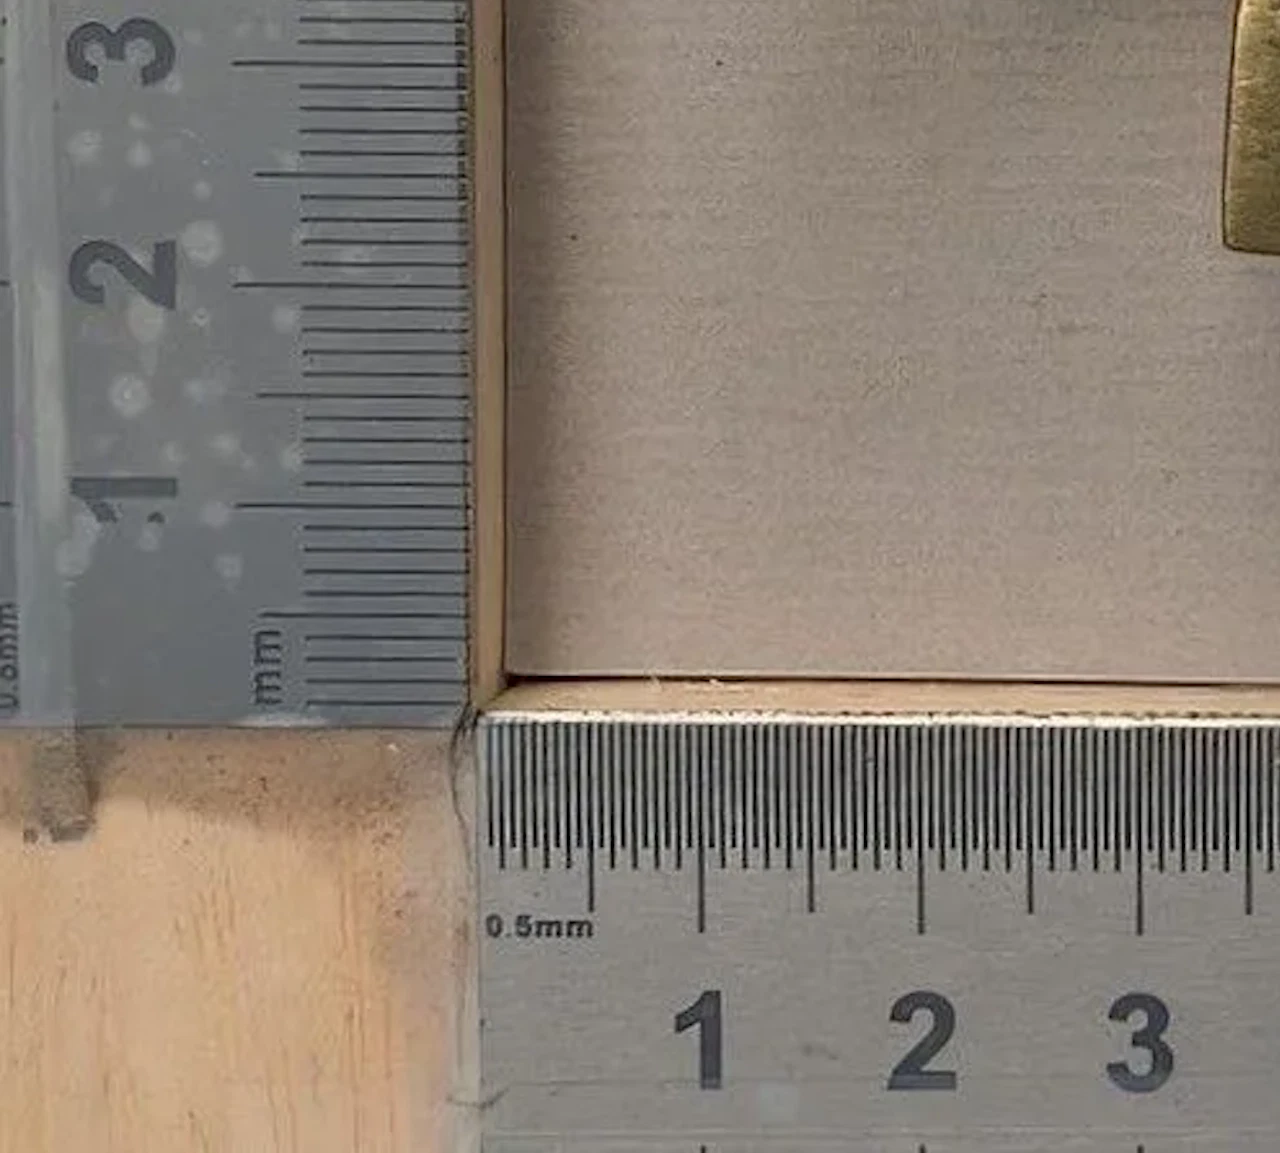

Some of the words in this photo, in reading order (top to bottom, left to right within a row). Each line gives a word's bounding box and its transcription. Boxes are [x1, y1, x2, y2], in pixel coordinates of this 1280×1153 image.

[66, 16, 177, 86] 3
[68, 239, 177, 310] 2
[69, 476, 178, 524] 1
[256, 628, 283, 706] mm
[485, 912, 594, 939] 0.5mm
[674, 989, 723, 1091] 1
[886, 990, 958, 1091] 2
[1105, 992, 1174, 1093] 3
